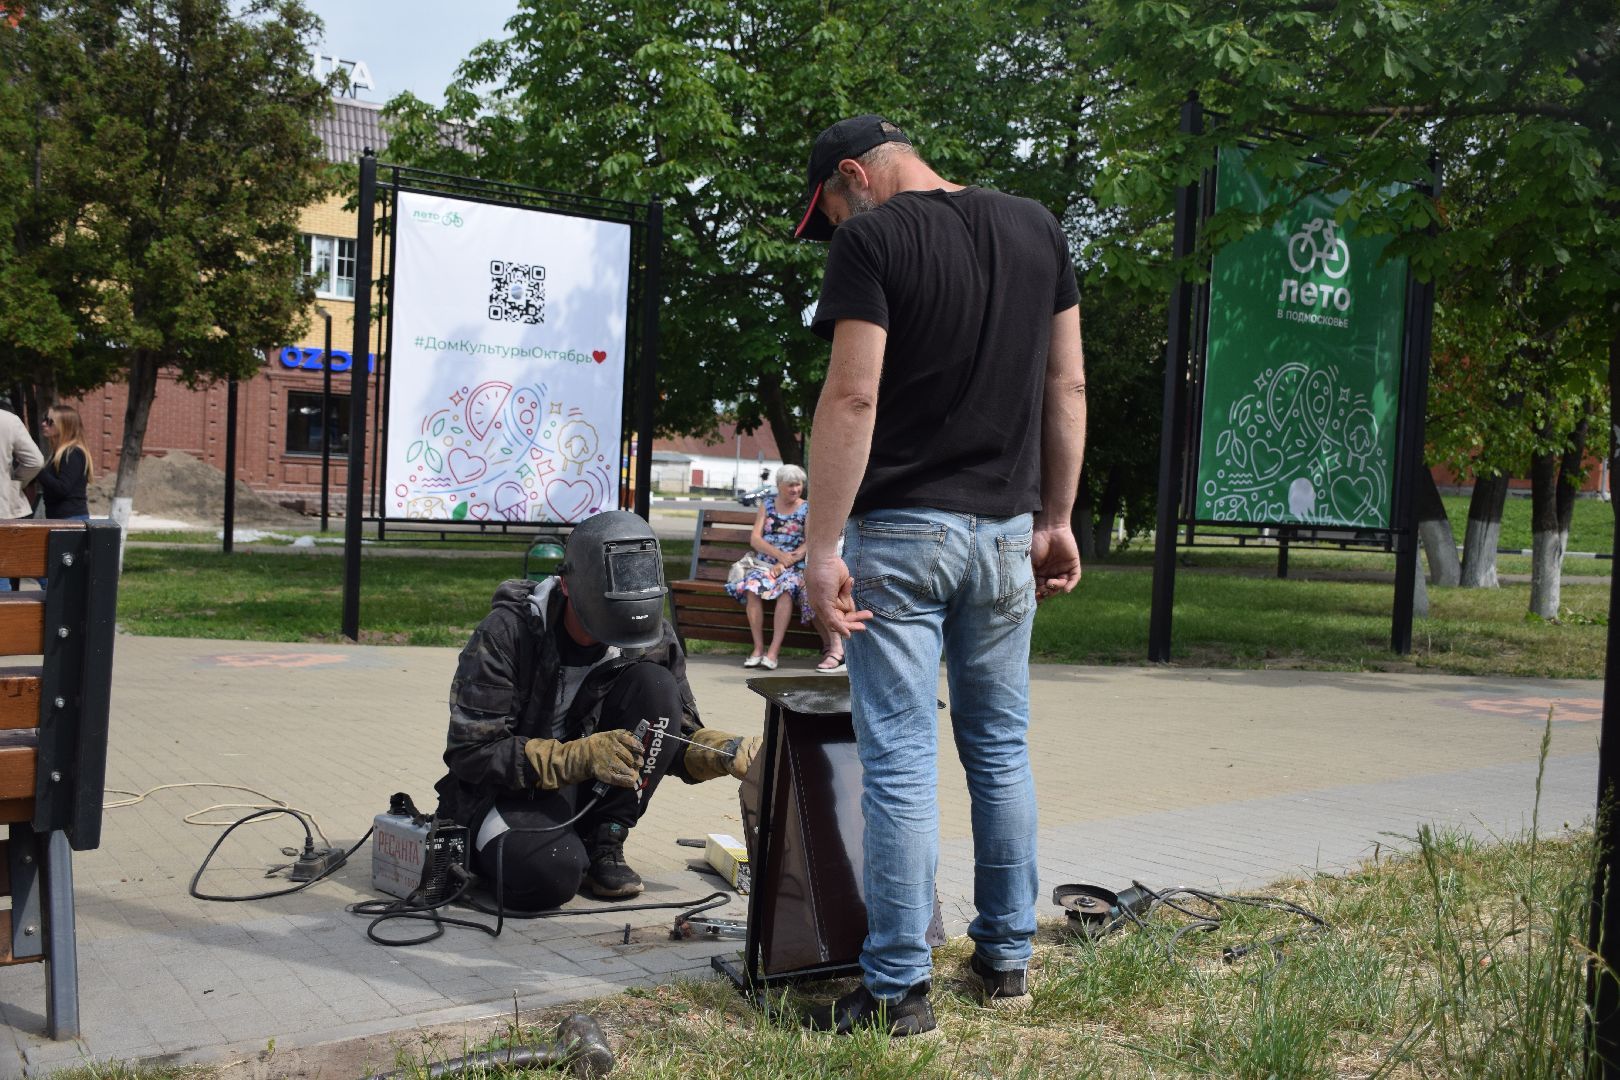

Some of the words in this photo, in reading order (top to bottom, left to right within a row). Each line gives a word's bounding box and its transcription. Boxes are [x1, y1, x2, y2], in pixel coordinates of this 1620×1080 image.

[1277, 308, 1284, 319] В
[1286, 310, 1349, 328] ПОДМОСКОВЬЕ
[280, 346, 374, 374] OZO
[414, 336, 593, 365] #ДомКультурыОктябрь
[643, 717, 670, 774] Reebok
[378, 831, 420, 866] РЕСАНТА
